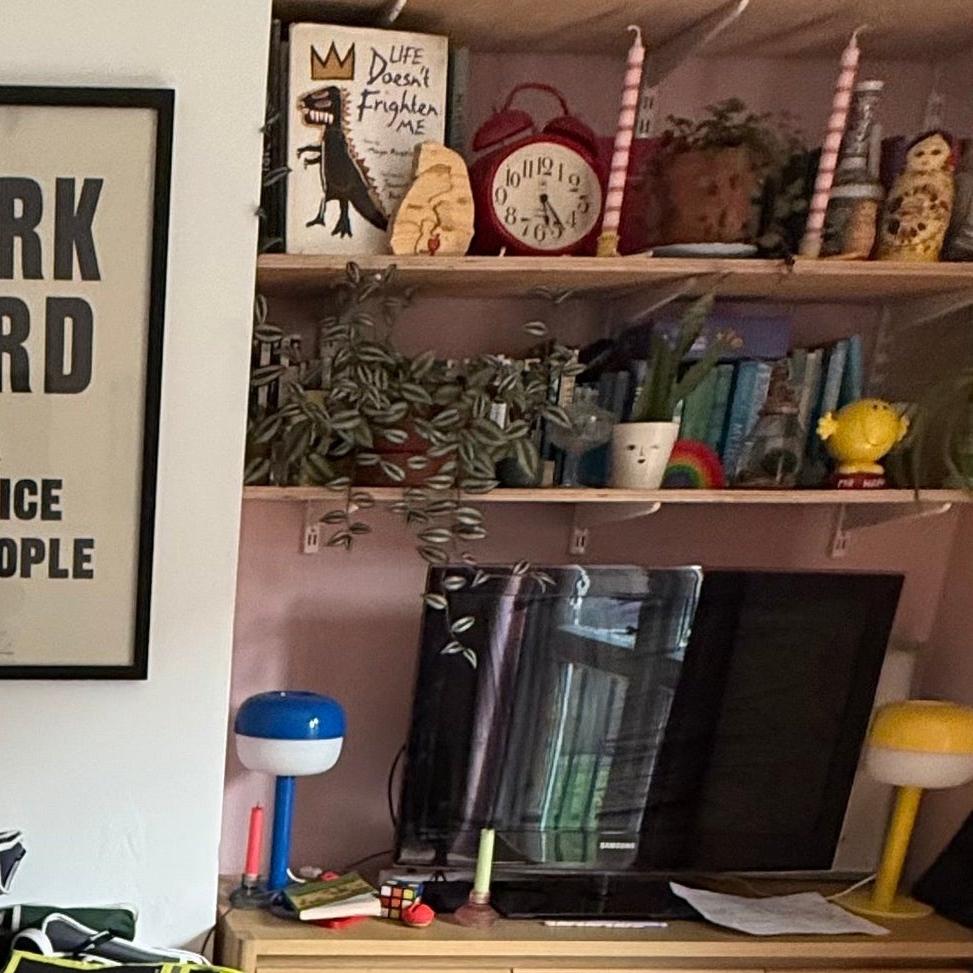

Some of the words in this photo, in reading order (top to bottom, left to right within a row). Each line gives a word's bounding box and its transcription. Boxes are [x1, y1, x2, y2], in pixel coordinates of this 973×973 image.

[389, 45, 423, 65] LIFE
[367, 47, 430, 88] Doesn't
[357, 89, 438, 128] Frighten
[395, 119, 426, 135] ME
[523, 160, 533, 178] 11
[537, 157, 553, 176] 12
[559, 163, 563, 182] 1
[507, 167, 520, 188] 10
[569, 173, 580, 192] 2
[495, 186, 507, 206] 9
[578, 195, 589, 213] 3
[505, 207, 516, 225] 8
[566, 210, 576, 228] 4
[520, 217, 530, 237] 7
[534, 224, 546, 242] 6
